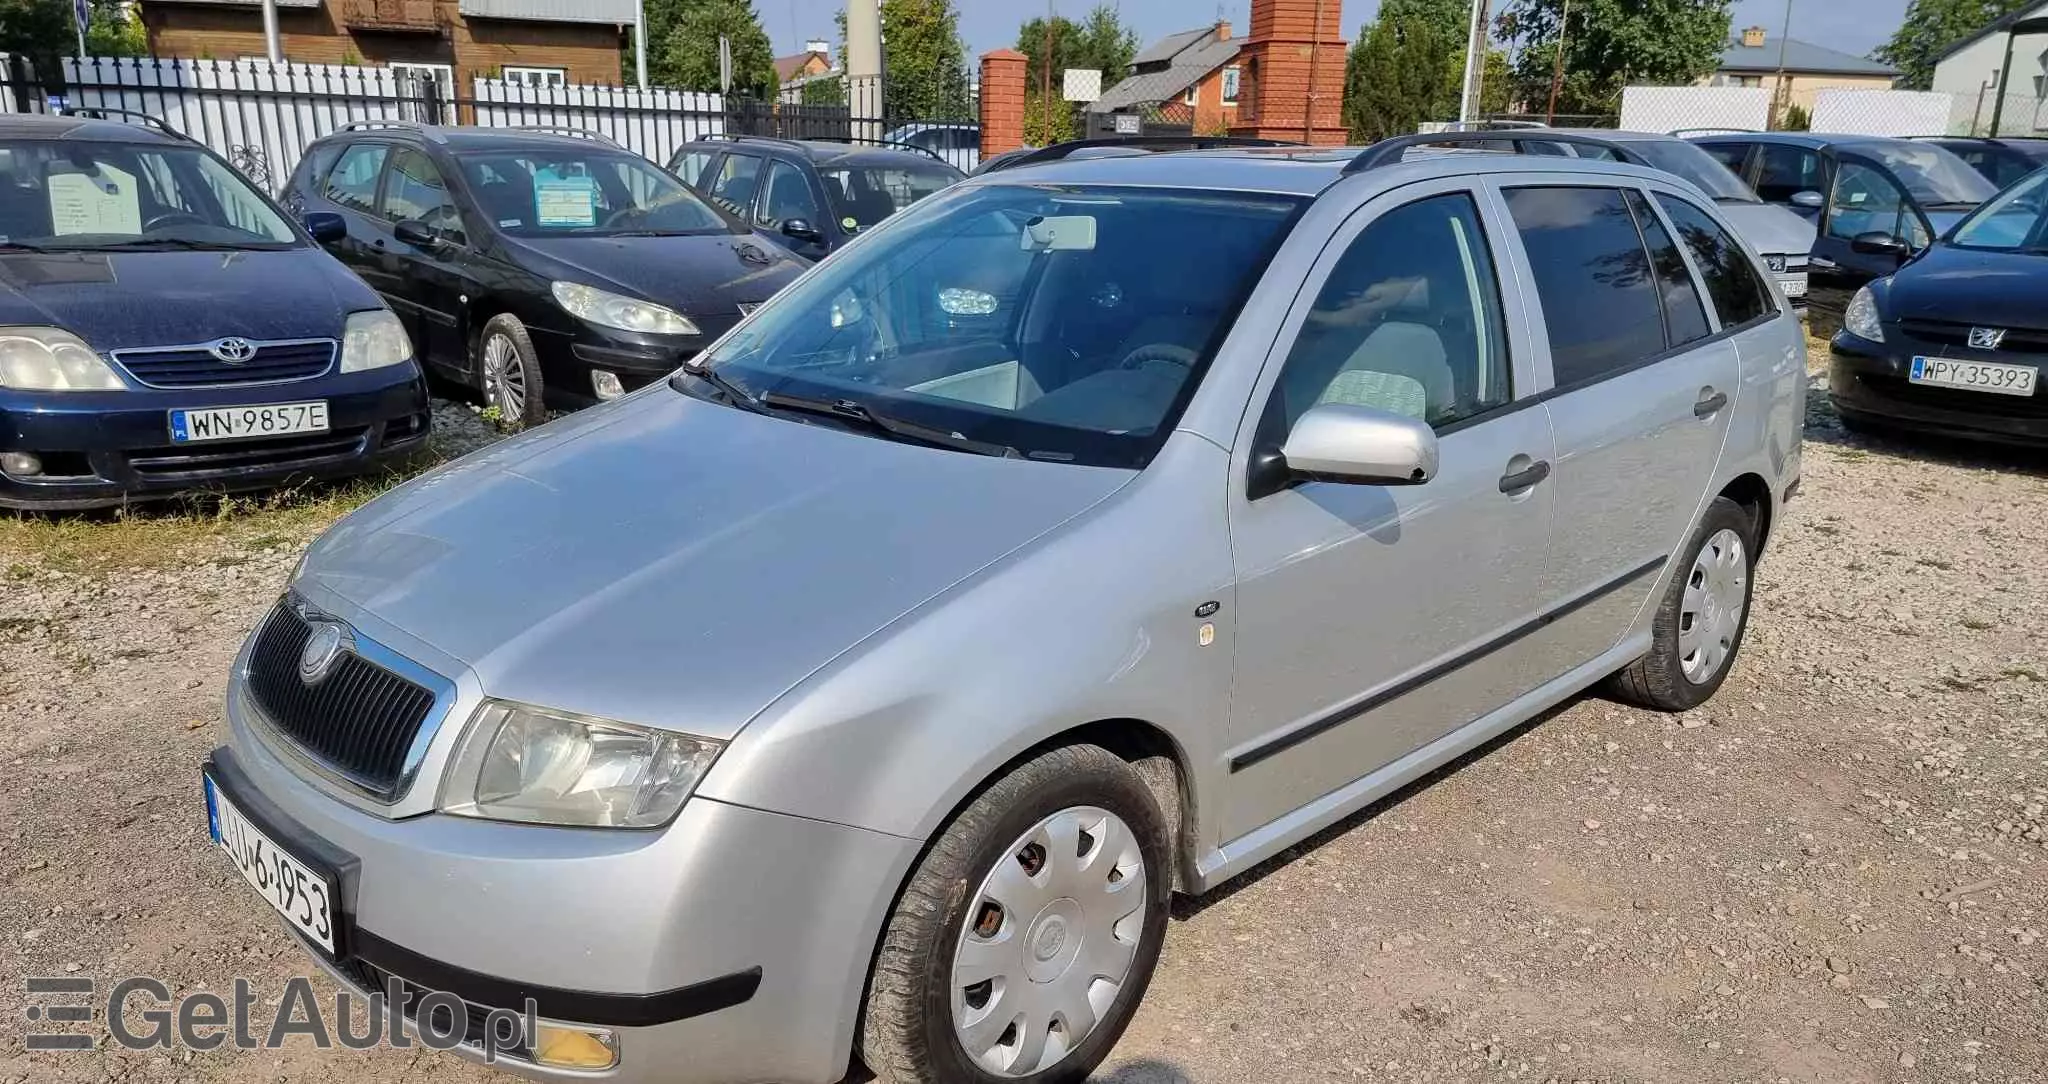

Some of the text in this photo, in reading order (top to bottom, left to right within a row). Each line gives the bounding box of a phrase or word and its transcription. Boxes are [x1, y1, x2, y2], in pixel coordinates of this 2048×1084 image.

[1924, 360, 2031, 389] WPY 35393
[191, 405, 325, 437] WN 9857E
[255, 839, 330, 941] 61953
